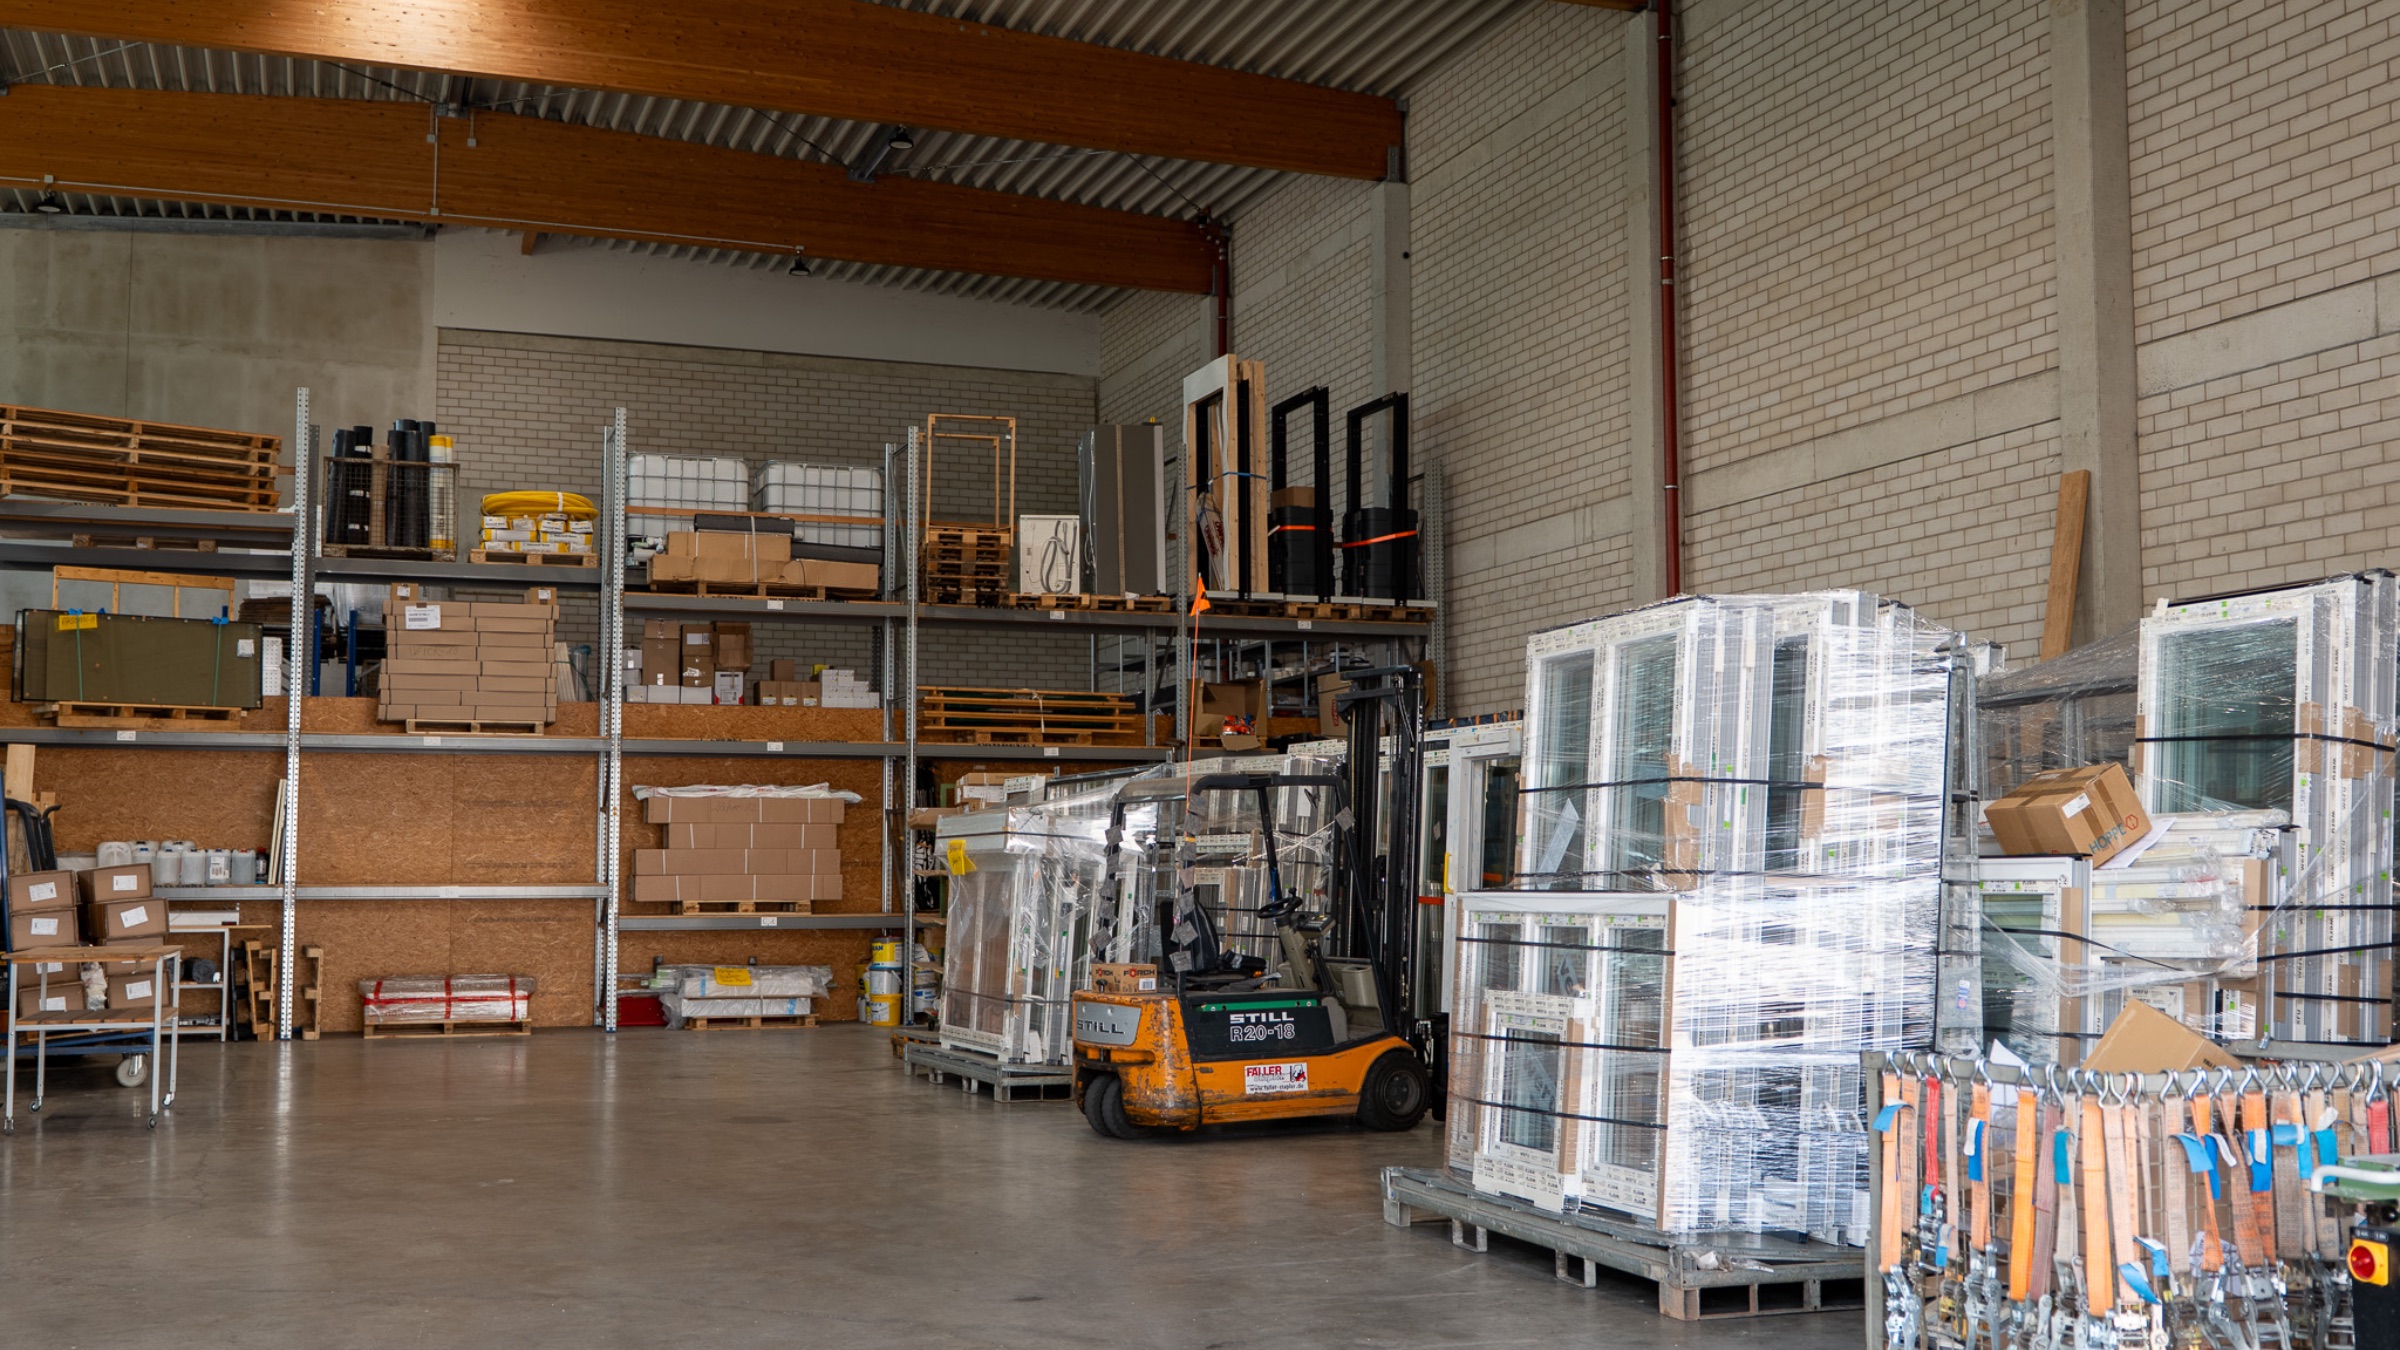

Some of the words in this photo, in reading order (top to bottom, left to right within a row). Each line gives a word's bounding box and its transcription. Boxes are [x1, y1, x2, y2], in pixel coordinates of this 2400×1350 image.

[1229, 1011, 1295, 1024] STILL
[1077, 1019, 1125, 1034] STILL
[1246, 1065, 1282, 1077] FALLER
